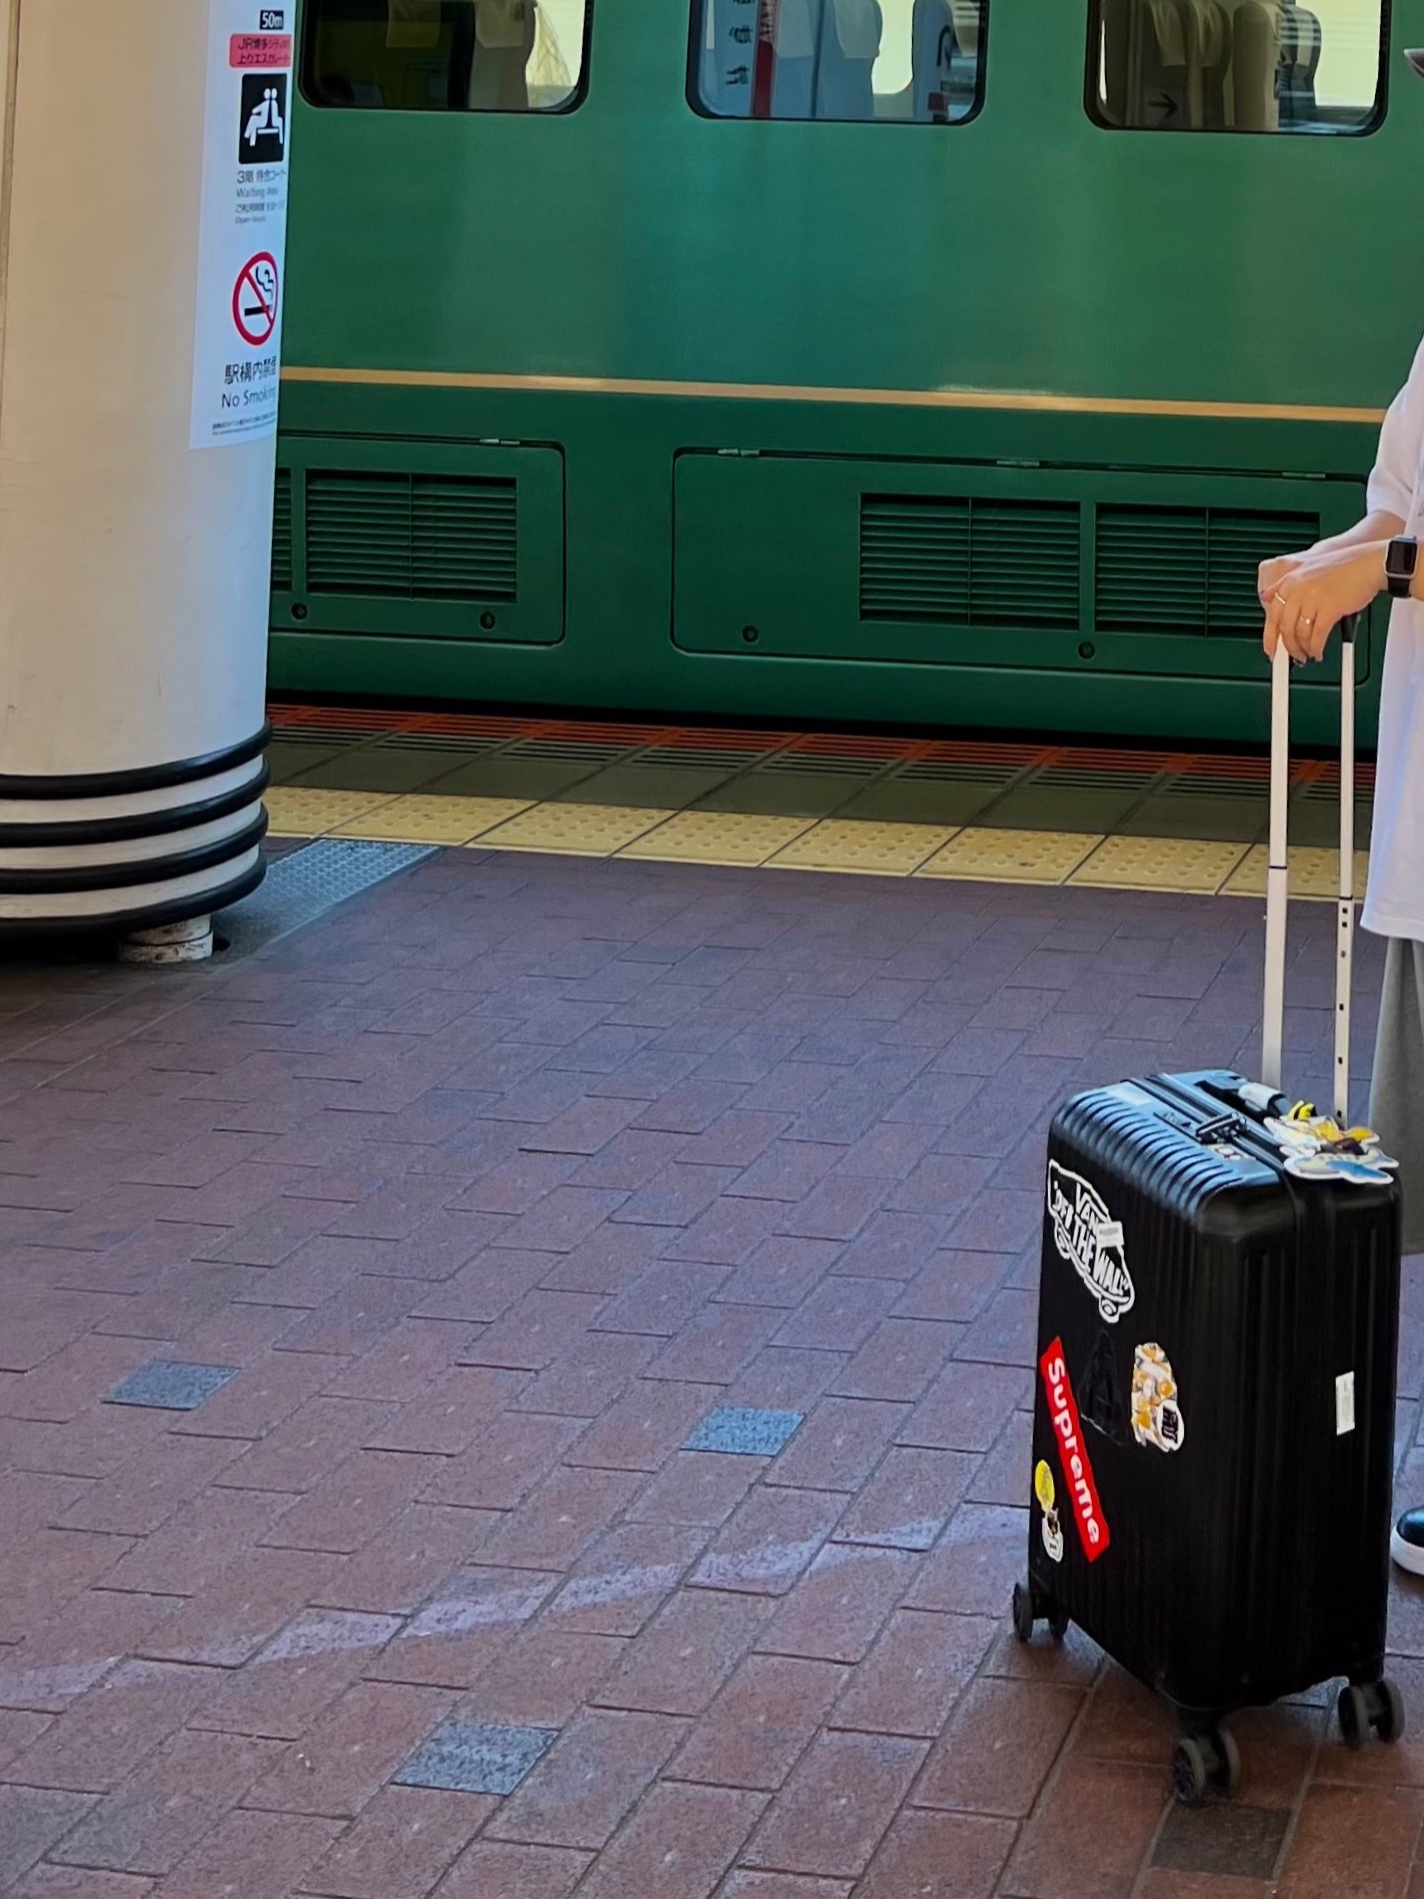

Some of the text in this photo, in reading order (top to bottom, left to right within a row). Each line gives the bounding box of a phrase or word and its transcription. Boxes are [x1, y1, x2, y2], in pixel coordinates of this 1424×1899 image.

[261, 11, 283, 28] 50m
[221, 392, 240, 409] No
[1048, 1356, 1101, 1544] Supreme
